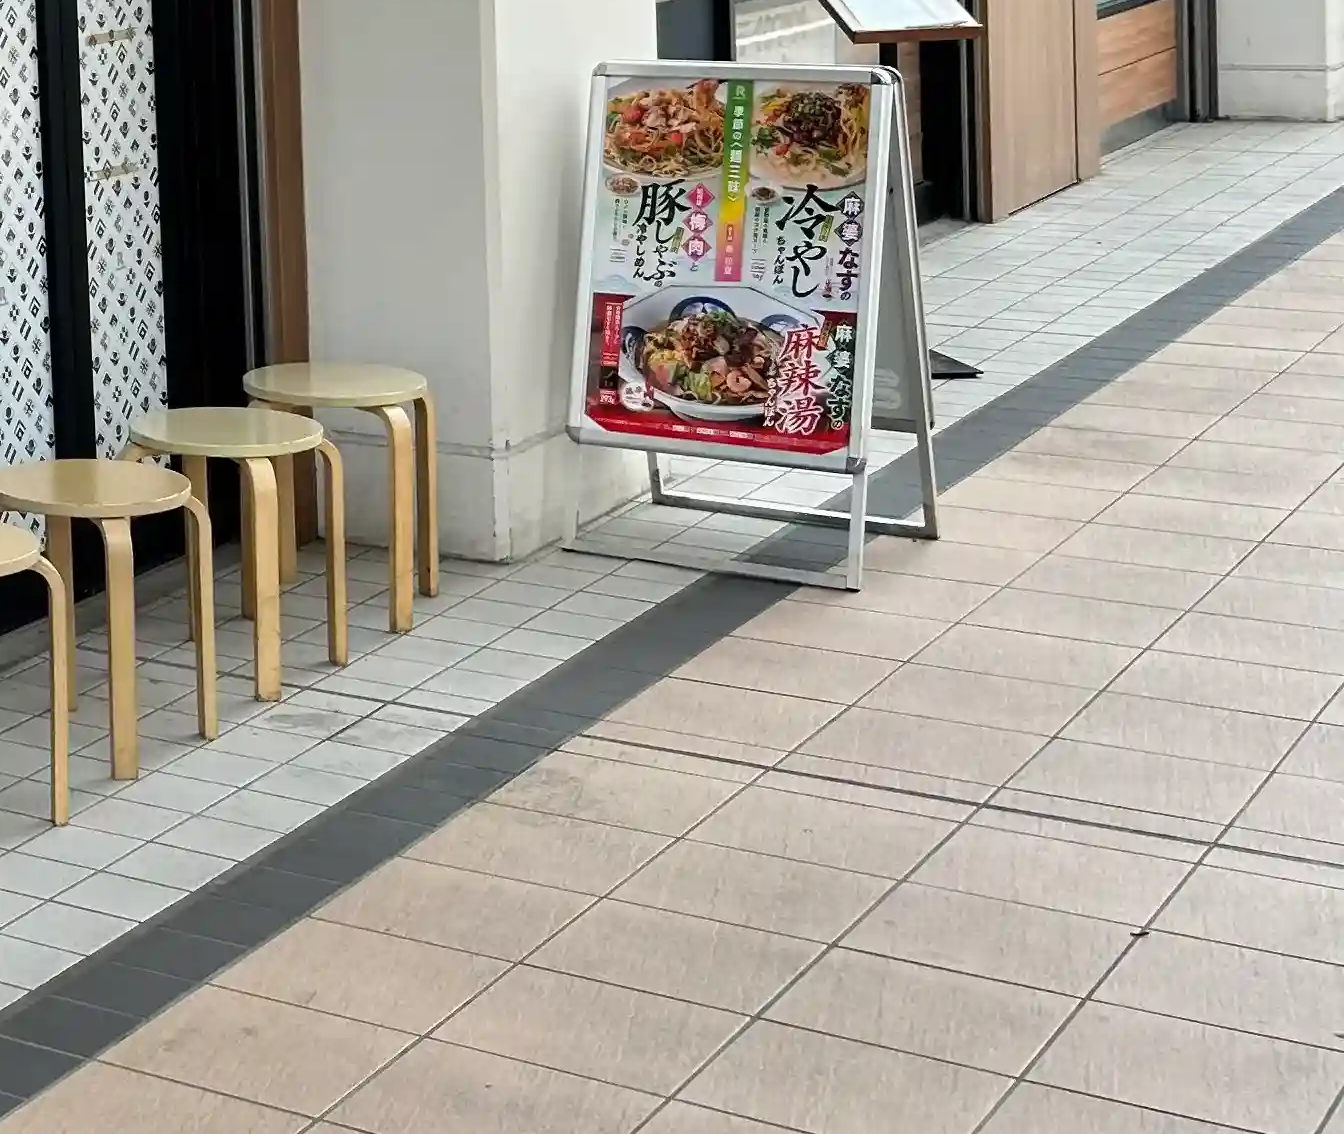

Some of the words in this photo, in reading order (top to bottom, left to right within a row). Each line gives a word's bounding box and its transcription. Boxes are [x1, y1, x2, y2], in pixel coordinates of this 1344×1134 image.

[631, 178, 693, 288] 豚しゃぶの
[774, 183, 840, 298] 冷やし
[776, 323, 827, 436] 麻辣湯
